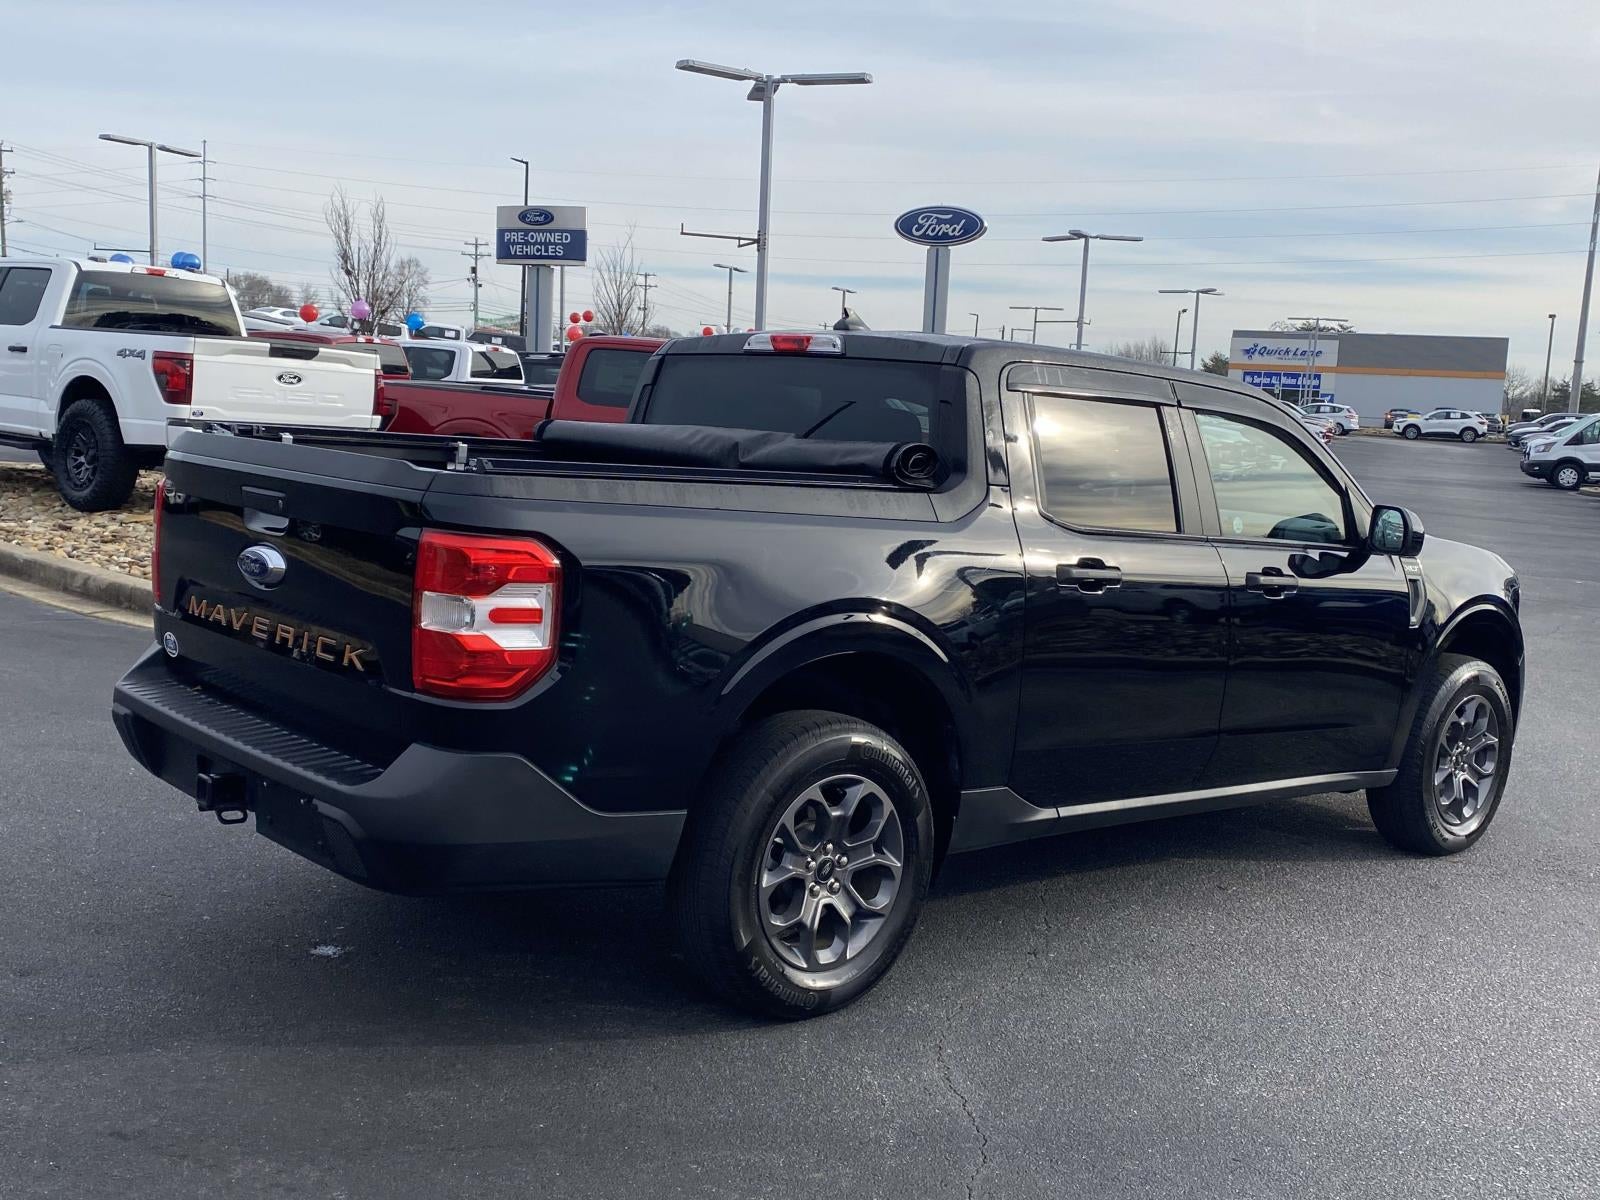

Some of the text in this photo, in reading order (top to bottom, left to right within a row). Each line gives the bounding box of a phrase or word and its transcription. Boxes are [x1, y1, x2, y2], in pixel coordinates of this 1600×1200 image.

[911, 212, 966, 237] Ford
[504, 231, 571, 243] PRE-OWNED
[509, 244, 564, 256] VEHICLES
[1257, 346, 1290, 356] Quick
[280, 373, 298, 385] Ford
[1271, 375, 1280, 384] ALL
[188, 595, 365, 672] MAVERICK
